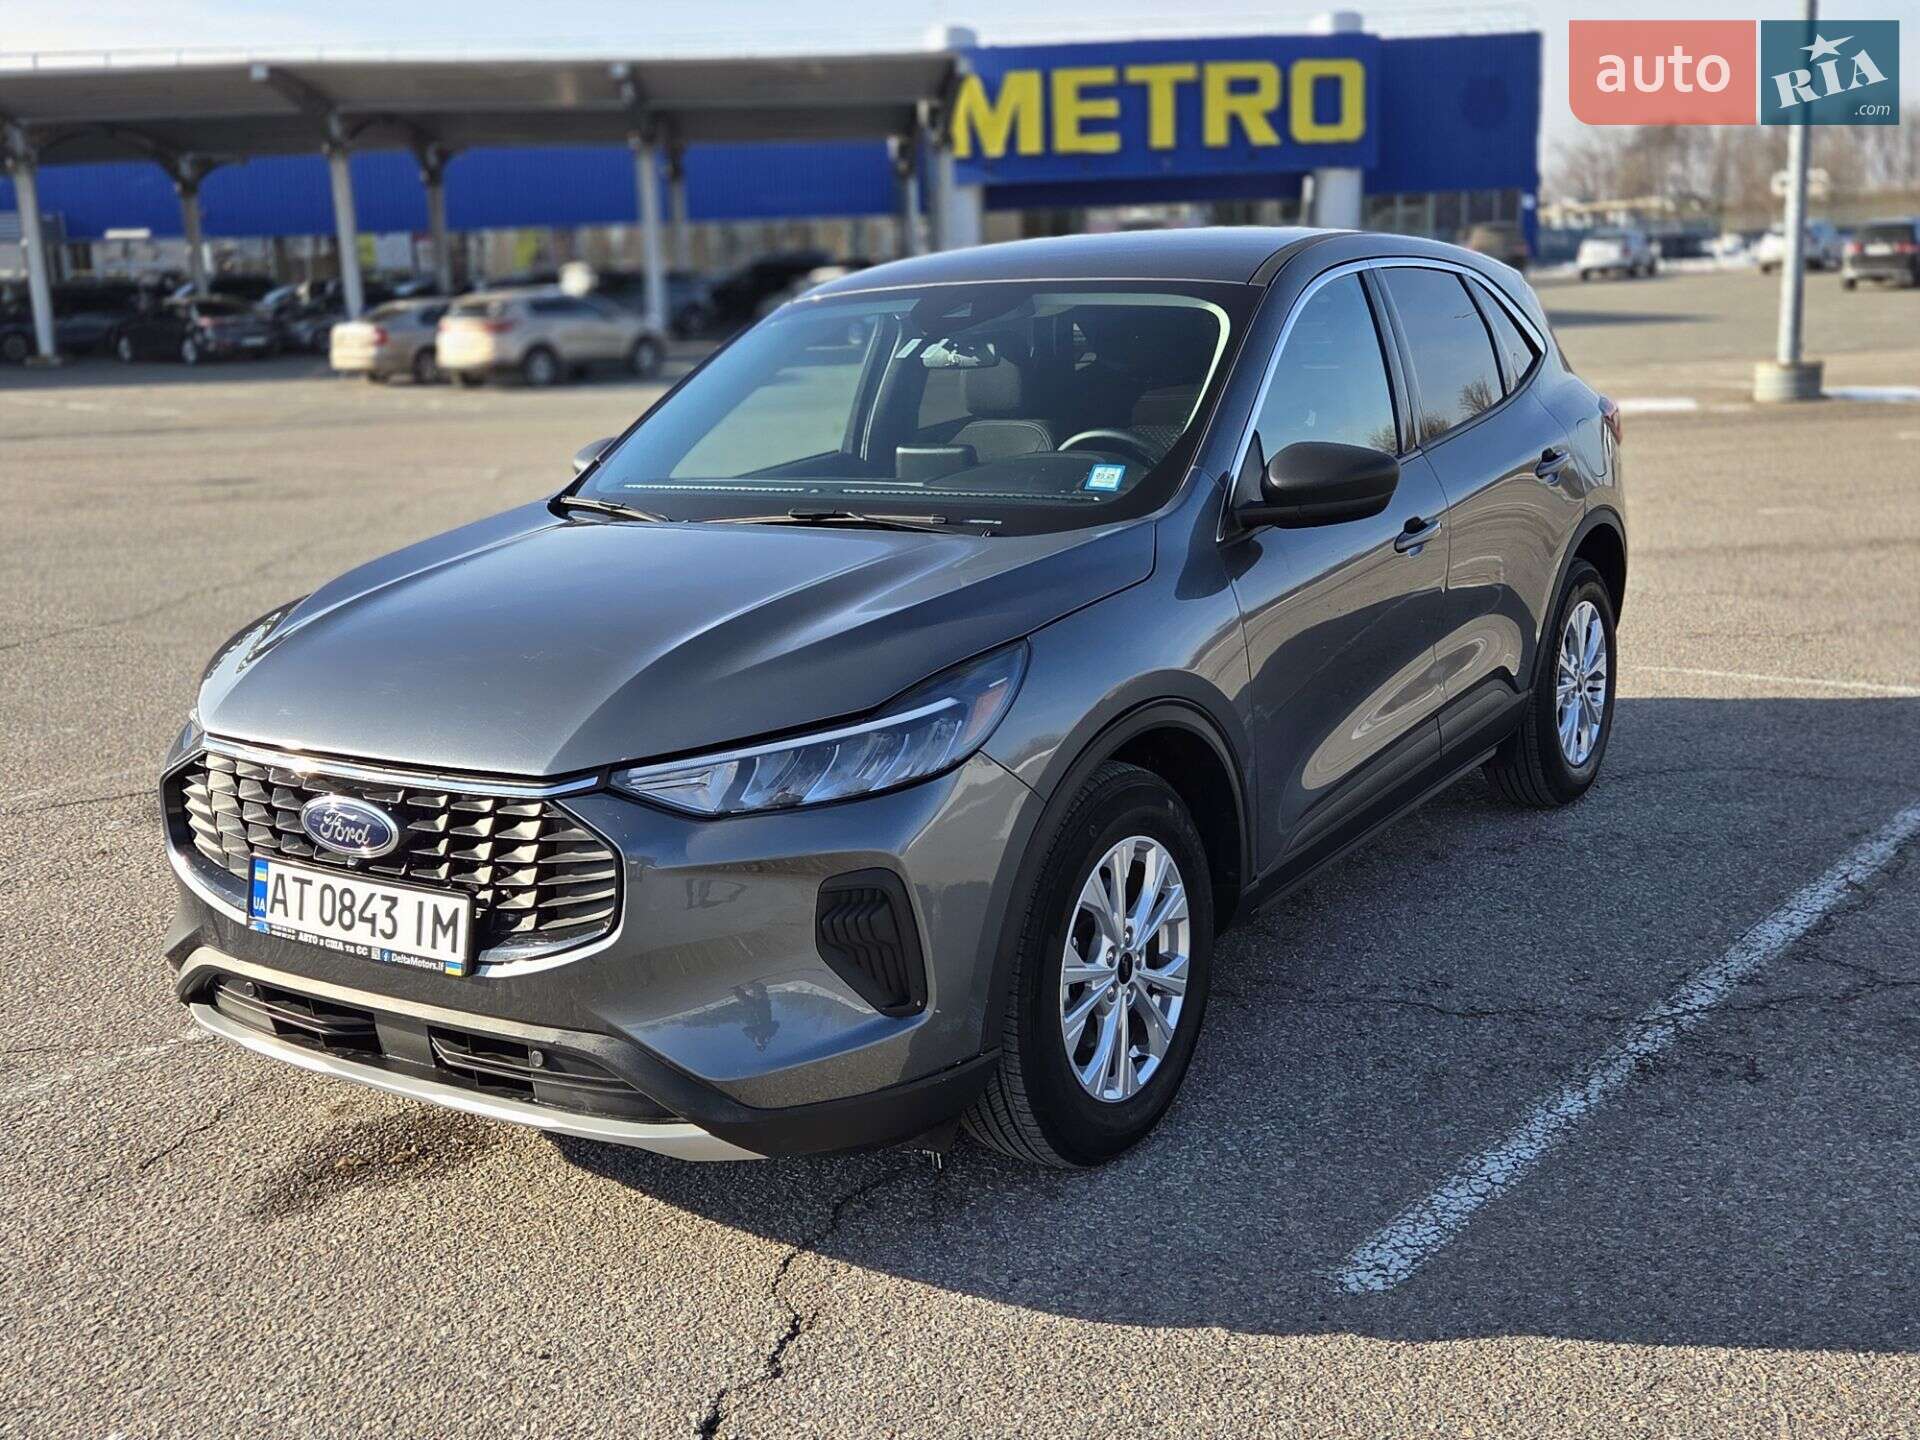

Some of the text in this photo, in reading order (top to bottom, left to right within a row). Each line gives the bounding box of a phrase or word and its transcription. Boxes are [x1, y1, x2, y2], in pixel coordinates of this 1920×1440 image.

[952, 57, 1367, 158] METRO
[319, 807, 371, 846] Ford
[252, 896, 266, 912] UA
[318, 883, 399, 940] 0843
